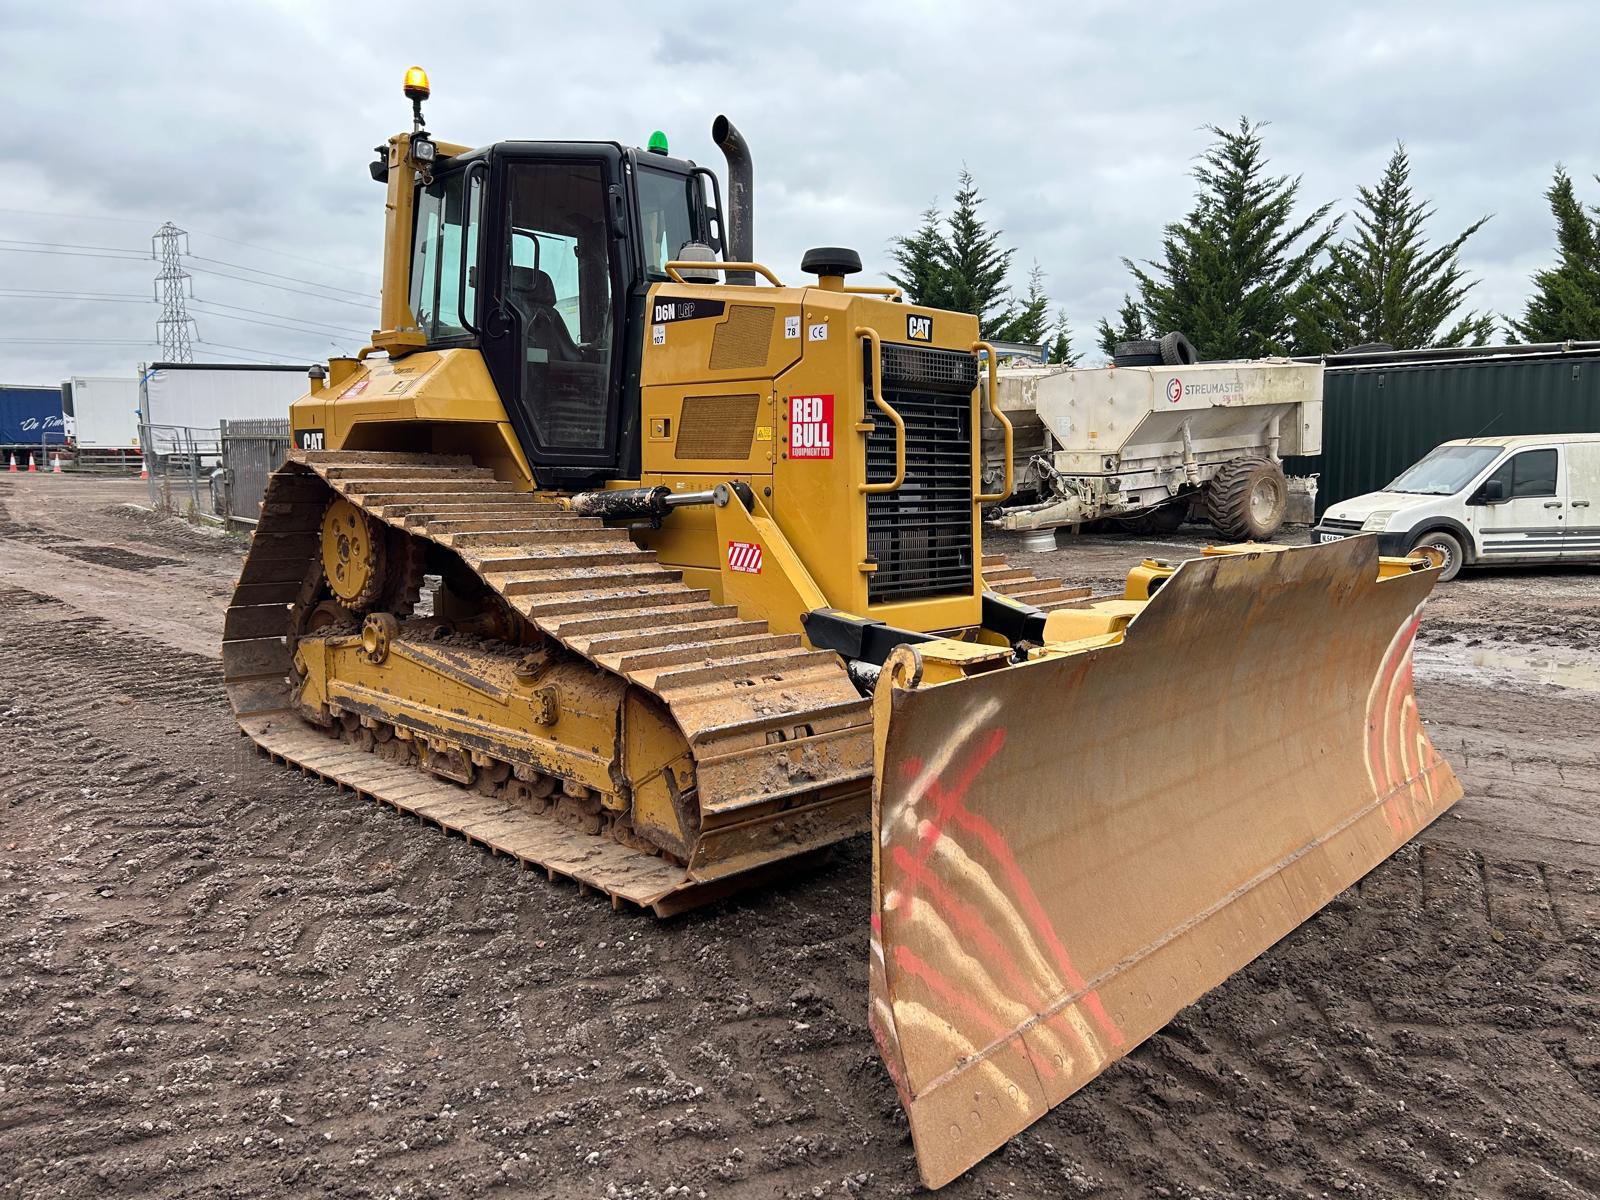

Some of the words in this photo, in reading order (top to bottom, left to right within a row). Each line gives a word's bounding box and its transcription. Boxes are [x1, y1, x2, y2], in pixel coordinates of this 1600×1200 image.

[655, 303, 676, 322] D6N
[677, 302, 696, 319] LGP
[787, 327, 796, 337] 78
[908, 316, 931, 341] CAT
[653, 335, 664, 344] 107
[1184, 383, 1244, 395] STREUMASTER
[792, 397, 823, 423] RED
[303, 432, 323, 450] CAT
[792, 422, 830, 448] BULL
[792, 447, 820, 458] EQUIPMENT
[820, 447, 830, 457] LTD
